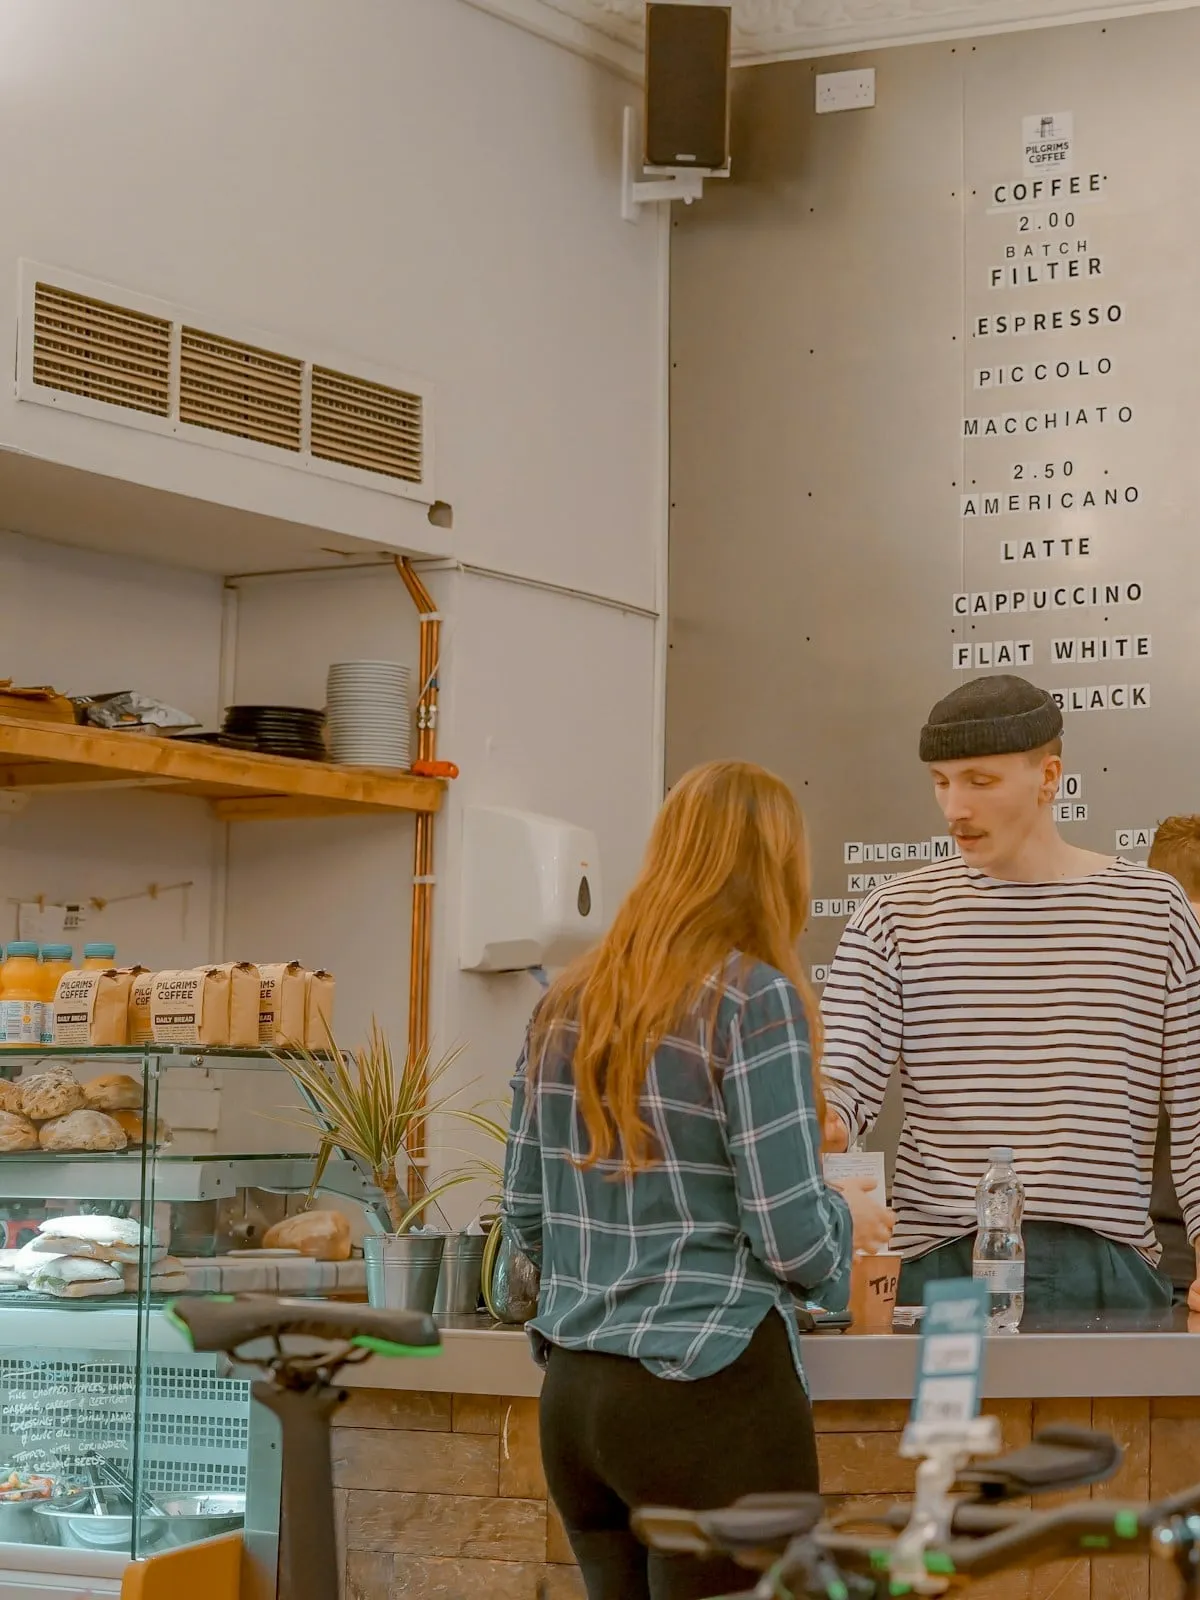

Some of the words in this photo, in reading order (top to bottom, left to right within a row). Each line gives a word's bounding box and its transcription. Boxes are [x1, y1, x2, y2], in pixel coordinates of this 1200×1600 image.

[1025, 142, 1069, 155] PILGRIMS
[1029, 152, 1066, 163] COFFEE
[994, 174, 1100, 203] COFFEE
[1020, 212, 1075, 231] 2.00
[1006, 240, 1087, 258] BATCH
[991, 258, 1101, 286] FILTER
[978, 305, 1122, 335] ESPRESSO
[979, 358, 1112, 386] PICCOLO
[964, 406, 1132, 435] MACCHIATO
[1013, 461, 1073, 480] 2.50
[964, 486, 1139, 515] AMERICANO
[1004, 537, 1089, 560] LATTE
[955, 583, 1141, 614] CAPPUCCINO
[958, 644, 1031, 665] FLAT
[1055, 638, 1148, 660] WHITE
[1053, 687, 1146, 709] BLACK
[1060, 806, 1086, 819] ER
[1119, 832, 1147, 847] CA
[848, 841, 949, 861] PILGRIM
[851, 875, 892, 889] KAY
[814, 901, 856, 914] BUR
[60, 980, 92, 990] PILGRIMS
[156, 980, 198, 990] PILGRIMS
[260, 980, 275, 989] IMS
[60, 989, 89, 999] COFFEE
[158, 990, 194, 1000] COFFEE
[260, 989, 272, 999] EE
[135, 996, 151, 1006] COF
[57, 1014, 71, 1023] DAILY
[155, 1015, 172, 1023] DAILY
[173, 1014, 194, 1023] BREAD
[61, 1414, 73, 1424] OF
[50, 1442, 70, 1453] WITH
[75, 1455, 105, 1466] SEEDS
